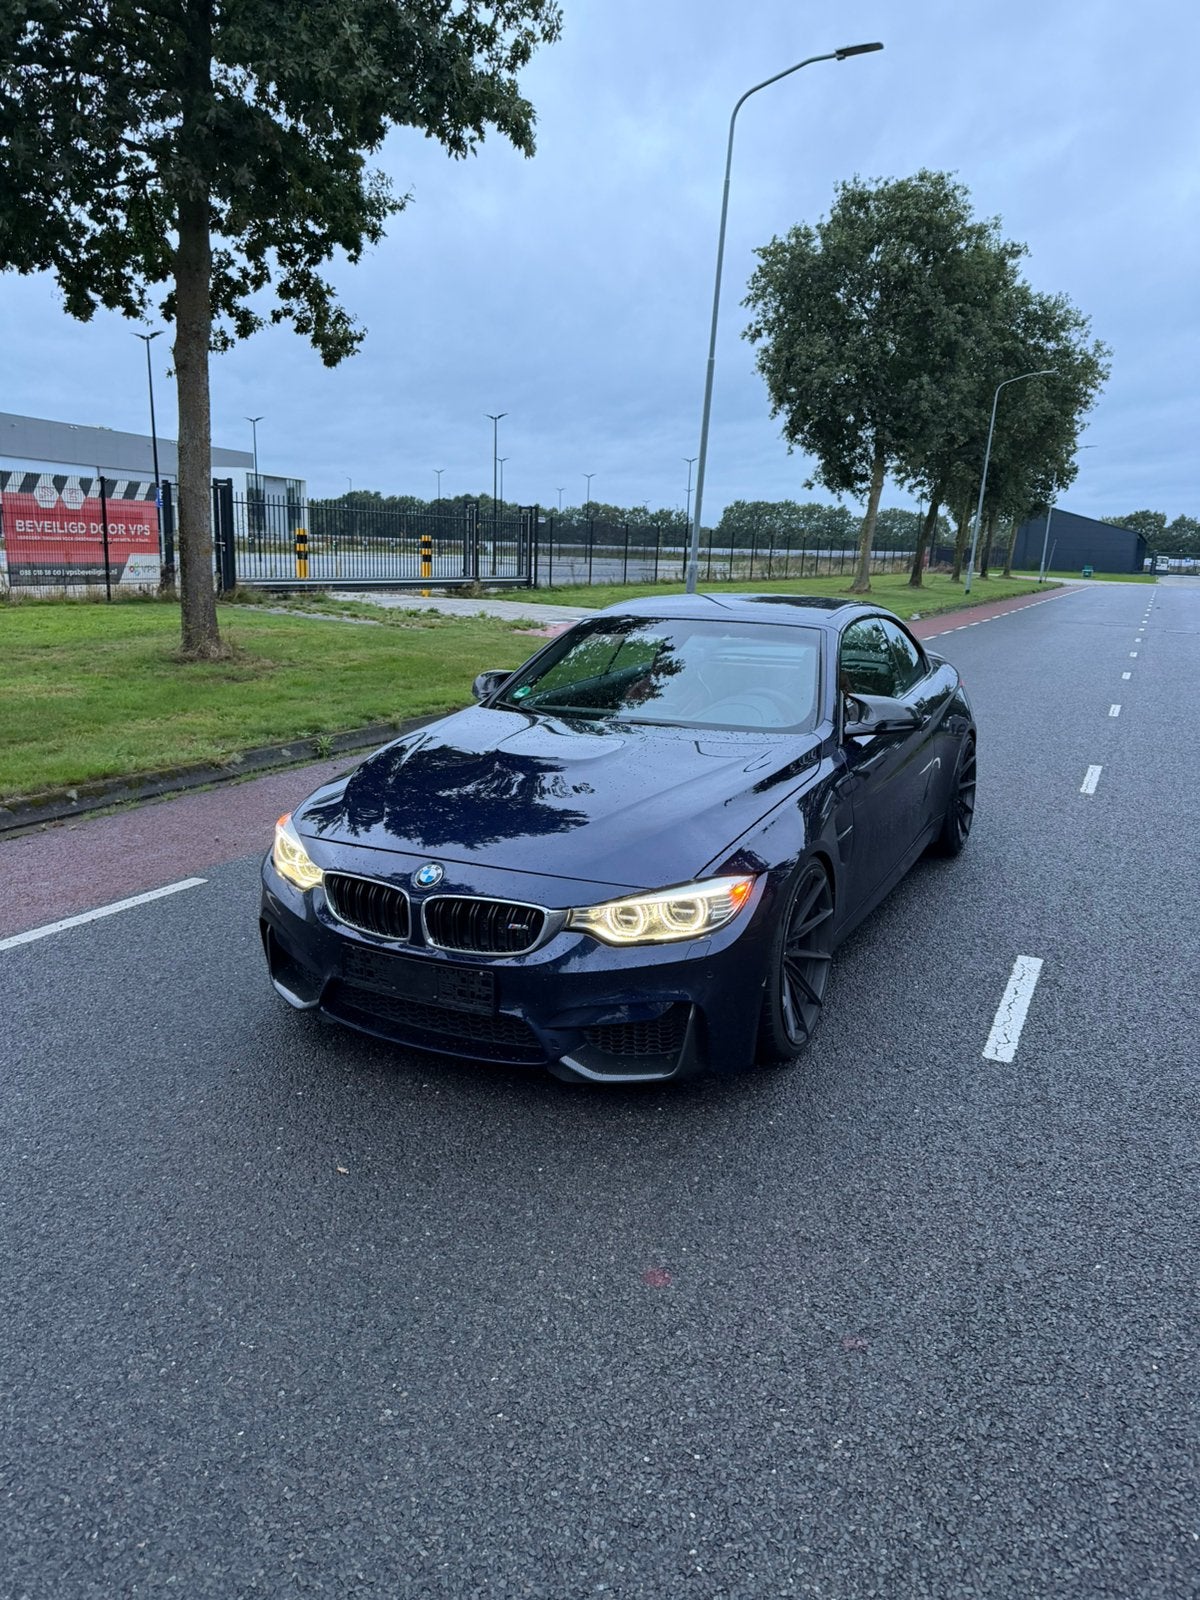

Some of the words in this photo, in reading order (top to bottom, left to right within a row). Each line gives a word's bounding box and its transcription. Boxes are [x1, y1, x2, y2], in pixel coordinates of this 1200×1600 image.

[15, 519, 87, 534] BEVEILIGD
[90, 522, 126, 535] DOOR
[128, 523, 151, 536] VPS
[141, 566, 157, 574] VPS
